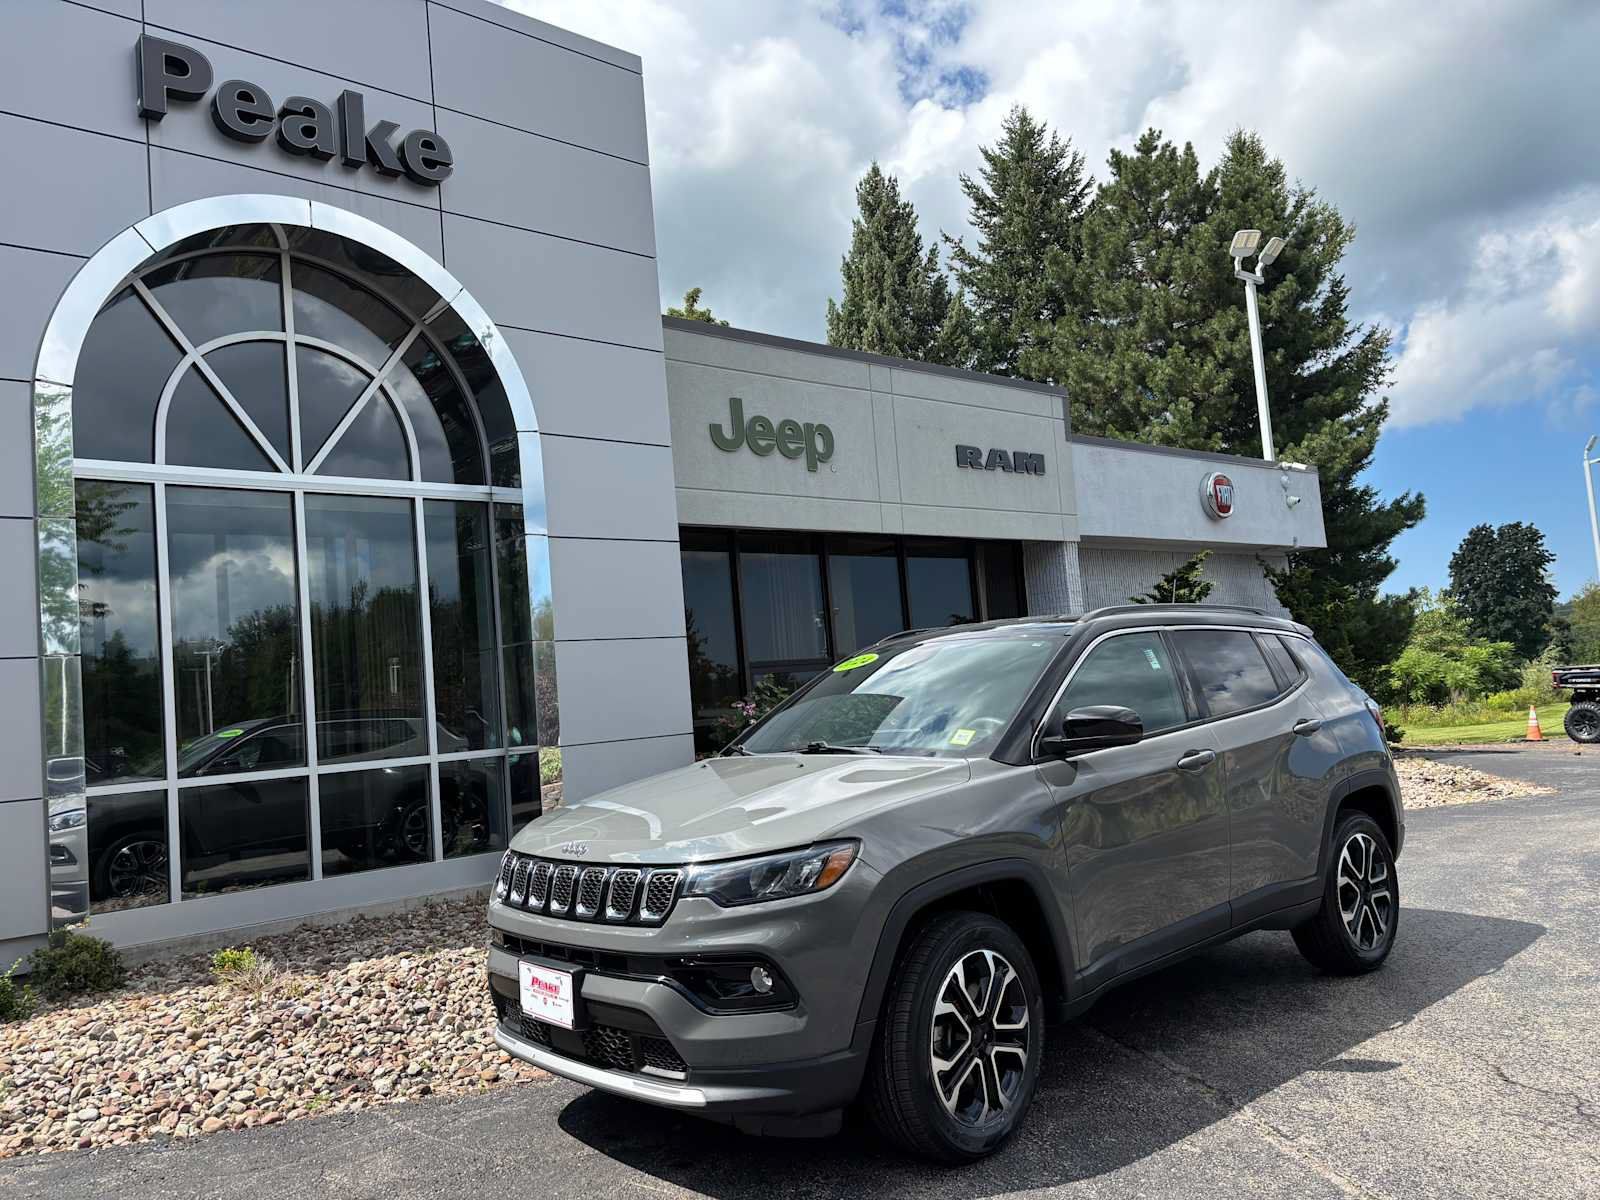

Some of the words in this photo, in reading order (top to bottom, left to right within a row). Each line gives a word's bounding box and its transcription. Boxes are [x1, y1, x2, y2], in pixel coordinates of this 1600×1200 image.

[135, 33, 453, 187] Peake
[709, 397, 835, 472] Jeep
[955, 444, 1046, 476] RAM
